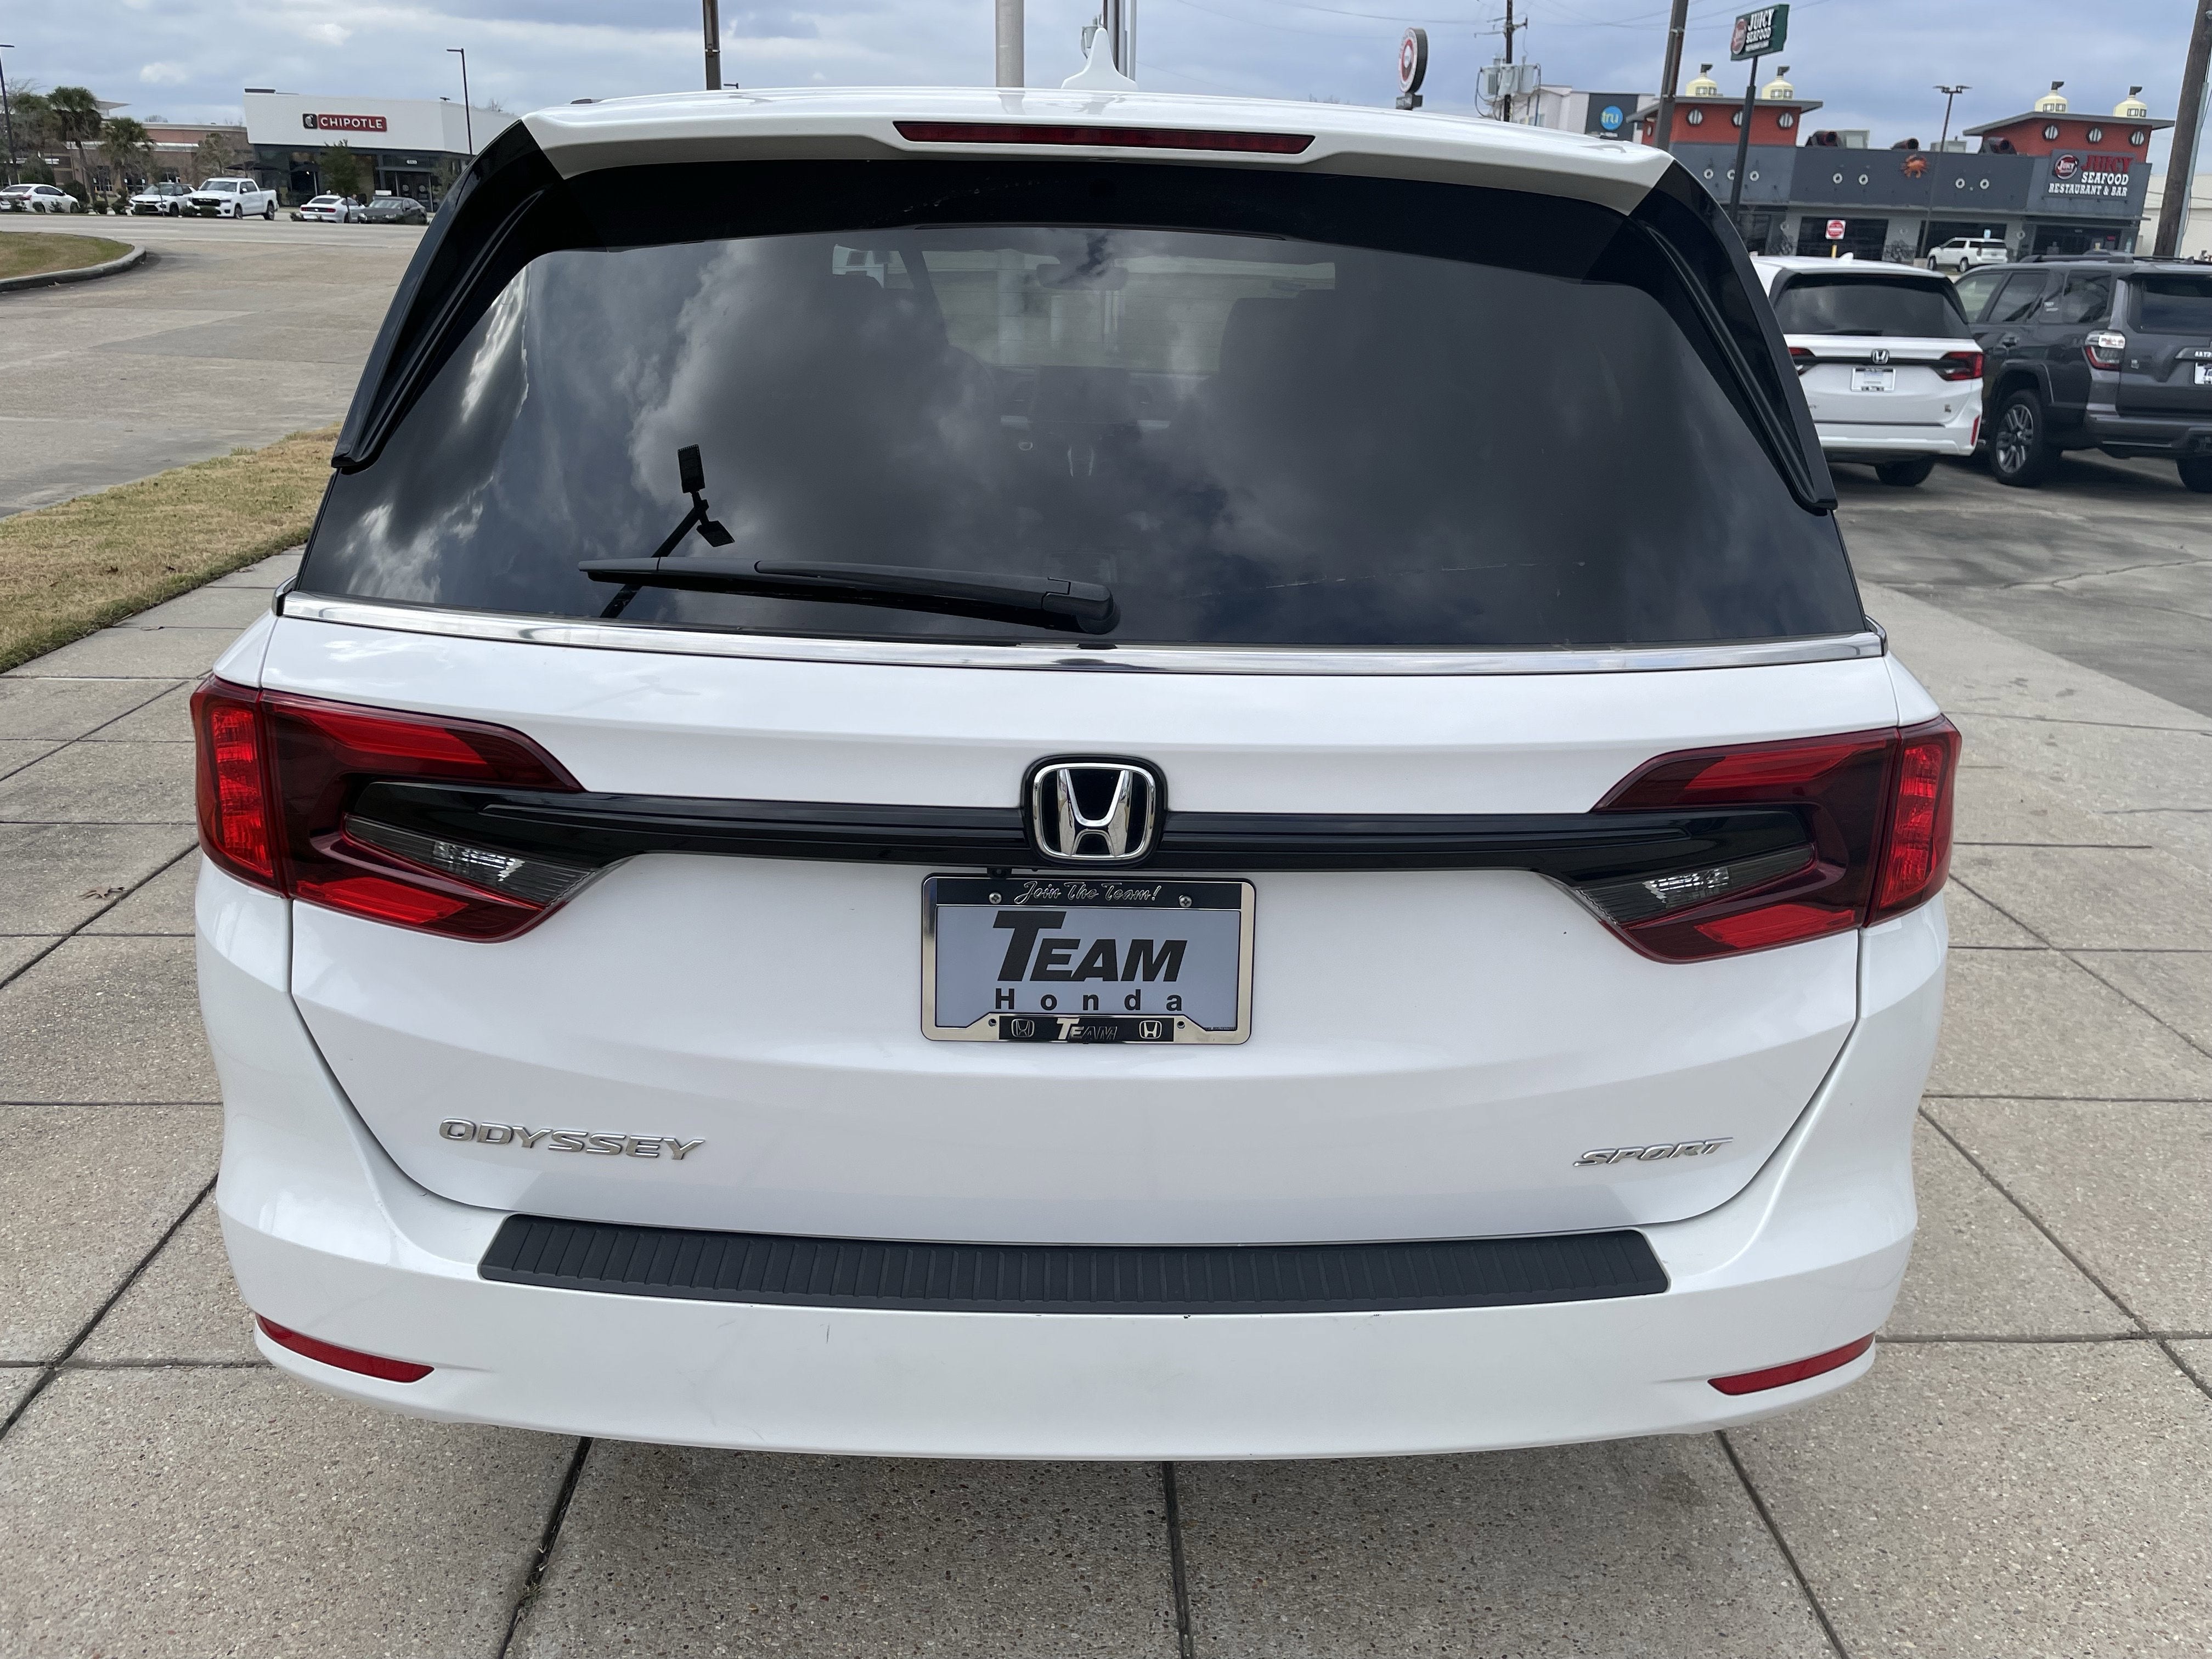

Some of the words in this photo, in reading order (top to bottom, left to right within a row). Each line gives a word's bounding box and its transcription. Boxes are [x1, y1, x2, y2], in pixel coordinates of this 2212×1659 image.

[1747, 9, 1774, 31] JUICY
[1746, 26, 1771, 43] SEAFOOD
[320, 117, 383, 129] CHIPOTLE
[1601, 111, 1619, 124] tru
[2081, 155, 2133, 173] JUICY
[2081, 171, 2129, 185] SEAFOOD
[2049, 183, 2102, 195] RESTAURANT
[2103, 185, 2109, 196] &
[2111, 186, 2128, 197] BAR
[1014, 881, 1062, 904] Join
[1064, 882, 1099, 900] The
[1101, 882, 1161, 901] Team!
[993, 911, 1188, 982] TEAM
[995, 988, 1183, 1011] Honda
[1056, 1017, 1118, 1041] TEAM
[439, 1118, 706, 1160] ODYSSEY
[1573, 1137, 1734, 1167] SPORT
